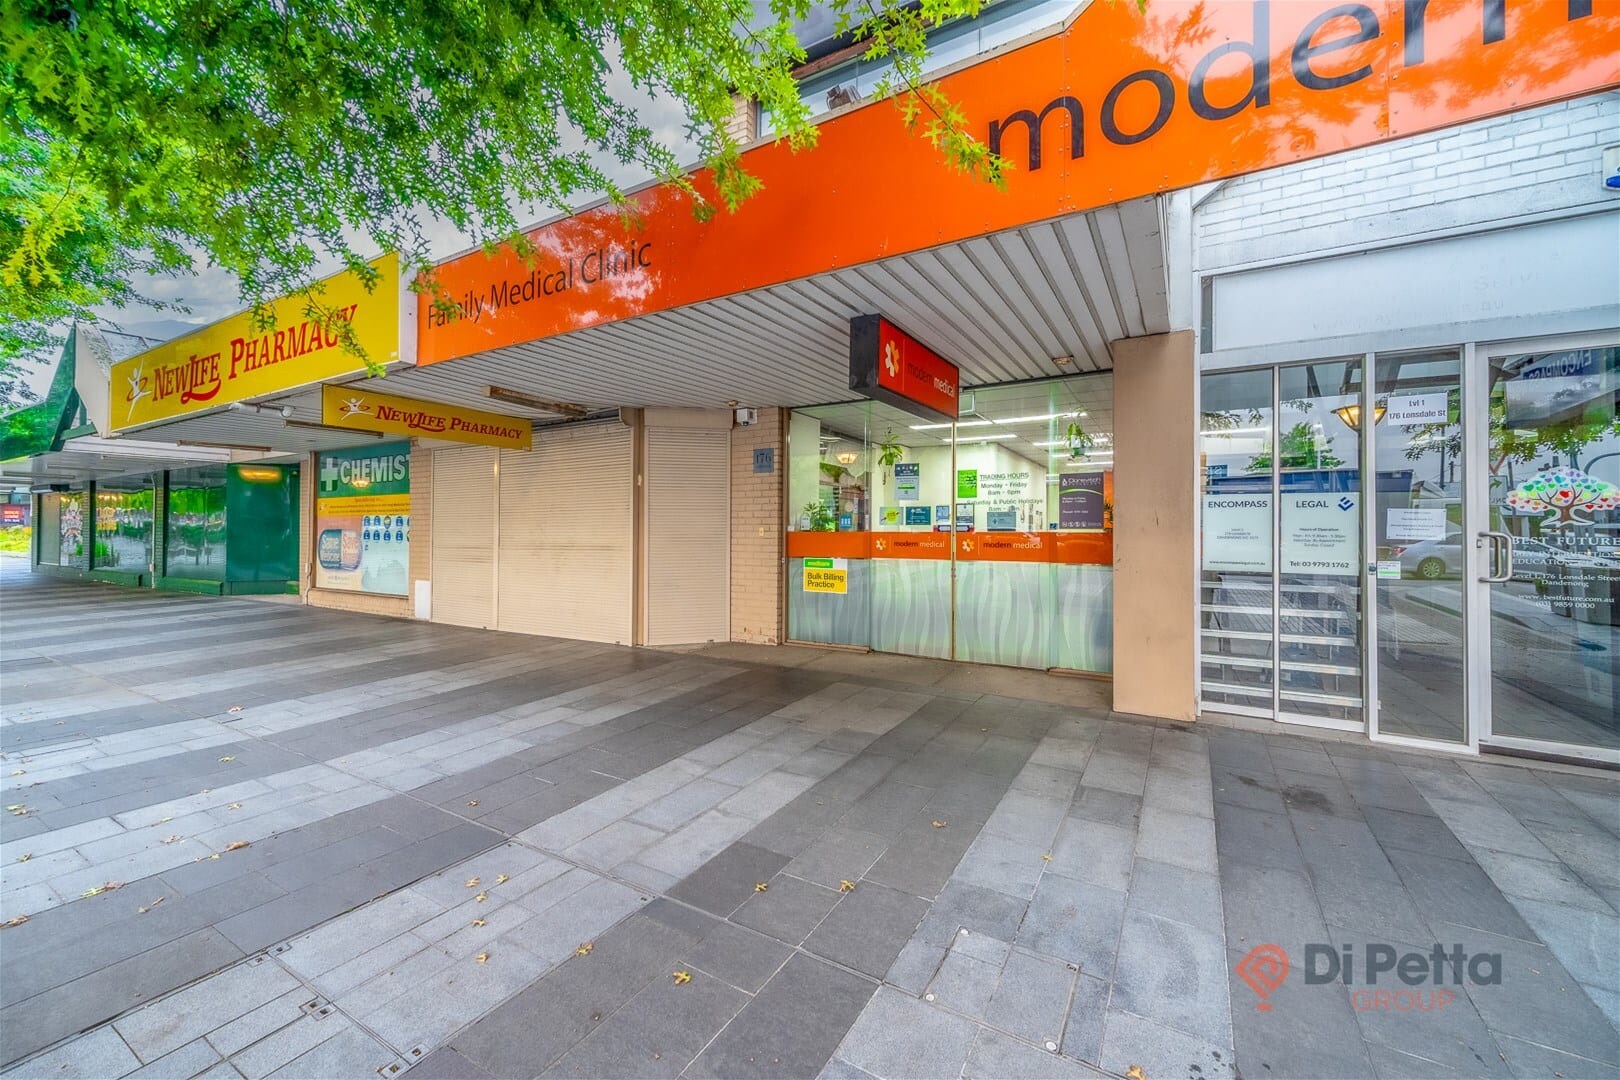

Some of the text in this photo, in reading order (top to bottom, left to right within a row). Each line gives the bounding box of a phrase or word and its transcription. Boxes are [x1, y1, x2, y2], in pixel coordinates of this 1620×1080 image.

[988, 0, 1592, 184] moder
[490, 259, 573, 310] Medical
[581, 239, 652, 285] Clinic
[909, 363, 955, 398] modern medical
[1402, 410, 1436, 419] Lonsdale
[1438, 409, 1447, 417] St
[1008, 472, 1029, 480] HOURS
[1208, 500, 1329, 508] ENCOMPASS LEGAL
[894, 540, 945, 548] modern medical
[984, 540, 1043, 549] modern medical
[1513, 537, 1620, 546] BEST FUTURE
[807, 572, 844, 582] Bulk Billing
[807, 580, 835, 588] Practice
[1541, 580, 1590, 588] Dandenong
